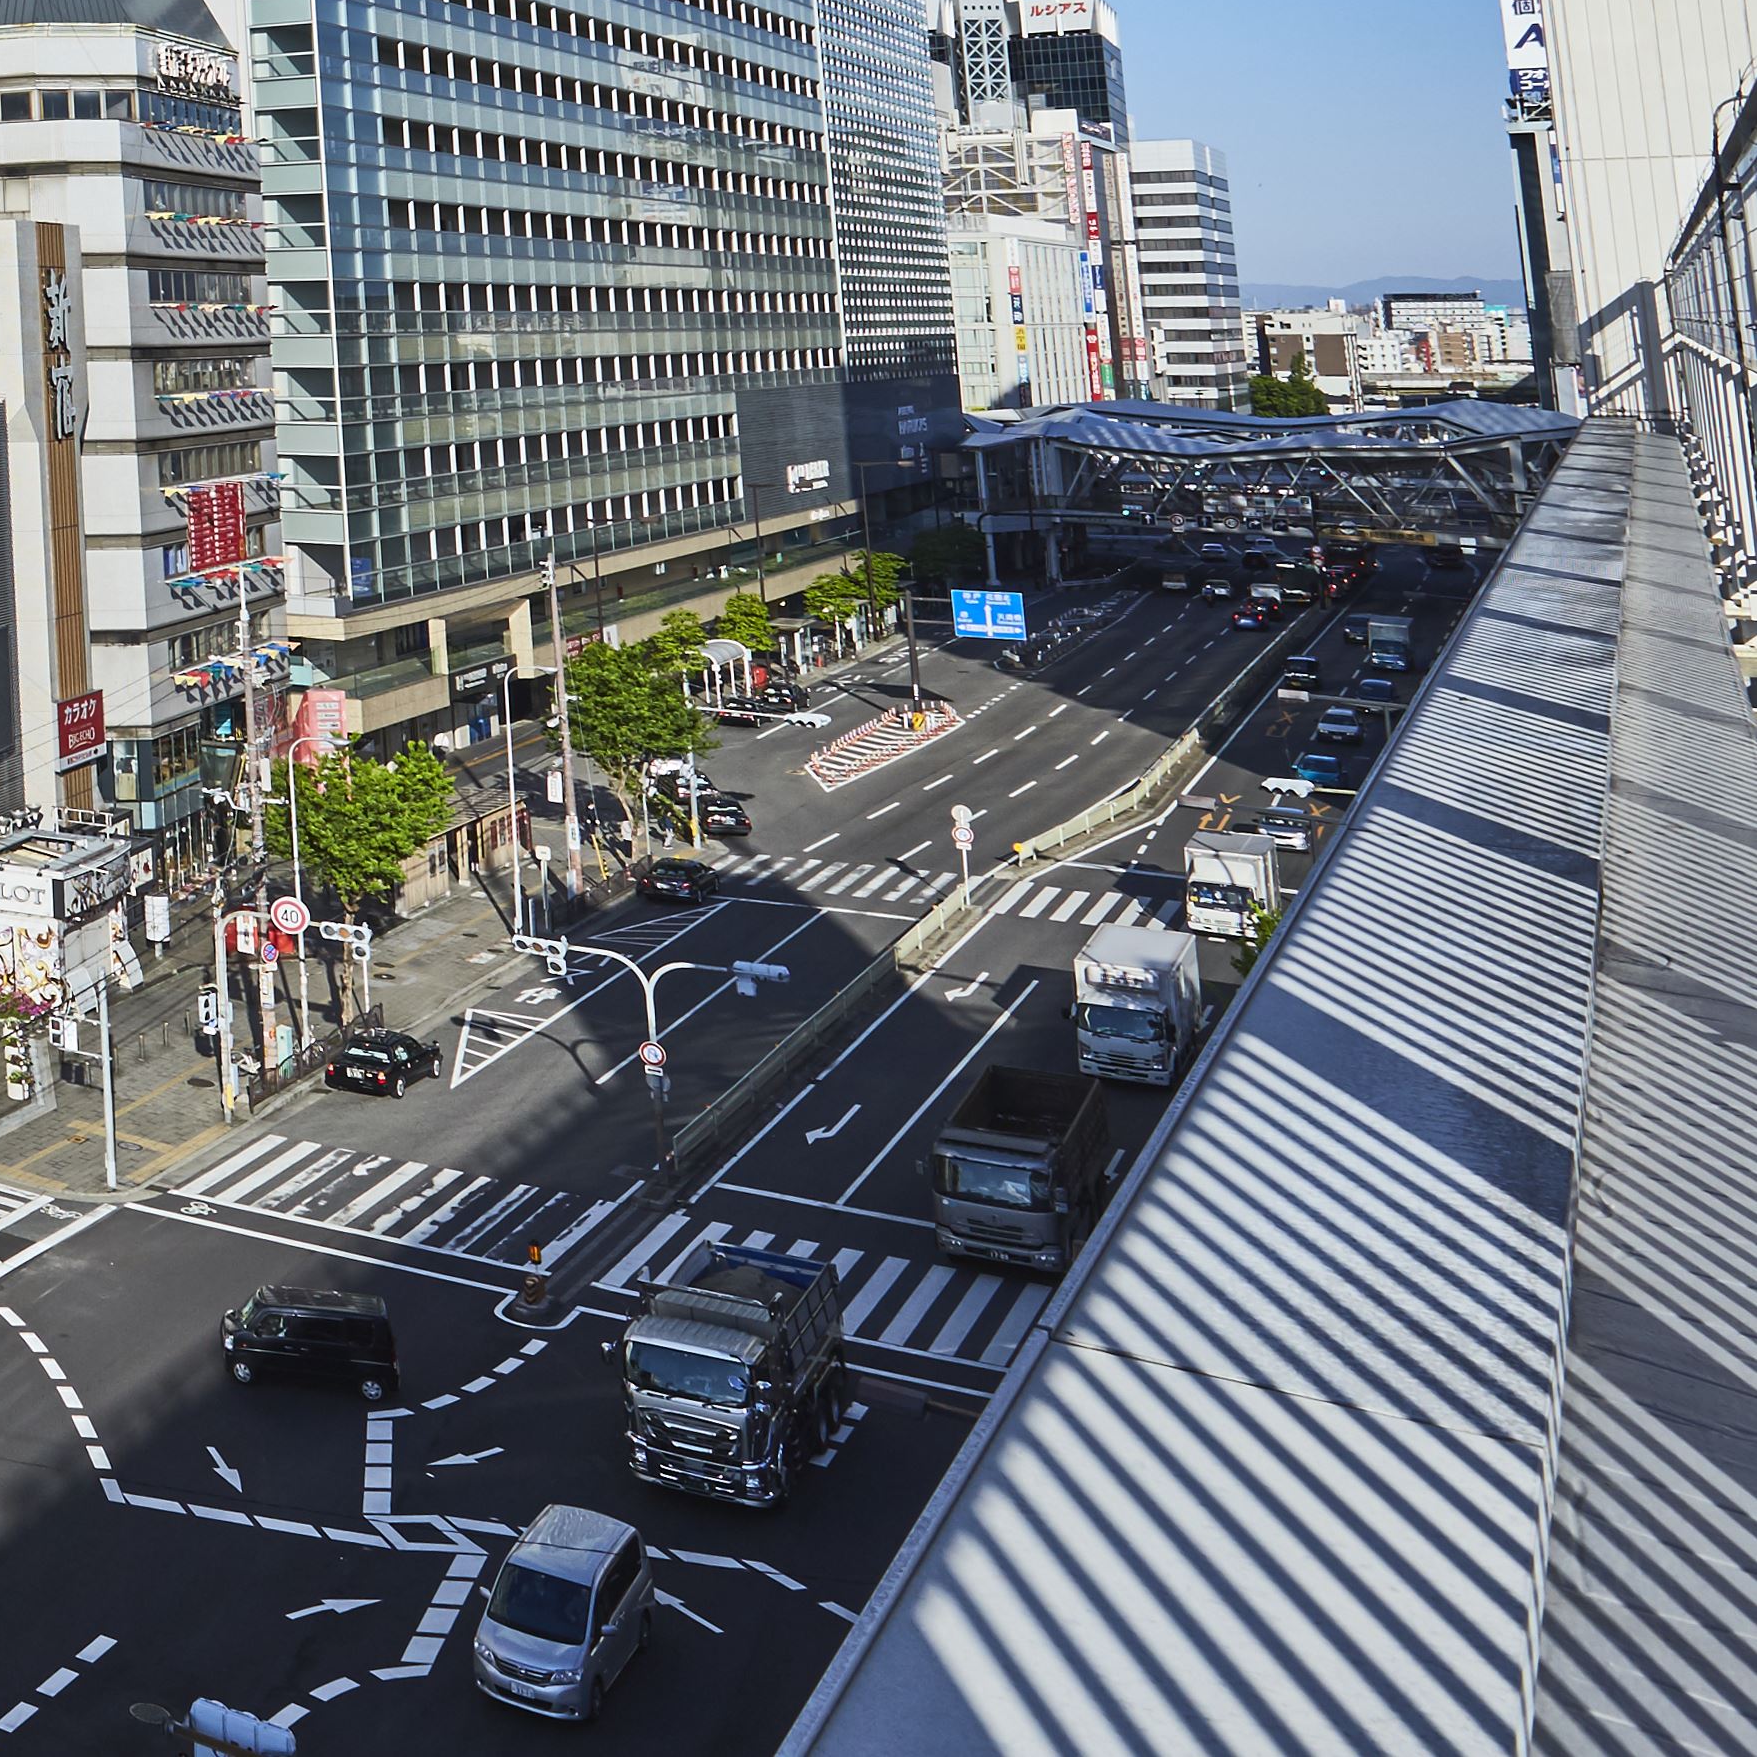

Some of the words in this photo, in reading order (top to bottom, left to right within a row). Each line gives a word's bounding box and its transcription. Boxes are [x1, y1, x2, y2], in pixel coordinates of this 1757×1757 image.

[1030, 1, 1087, 17] ルシアス
[46, 268, 77, 440] 新宿
[64, 698, 97, 726] カラオケ
[68, 732, 80, 749] BIG
[280, 909, 299, 924] 40
